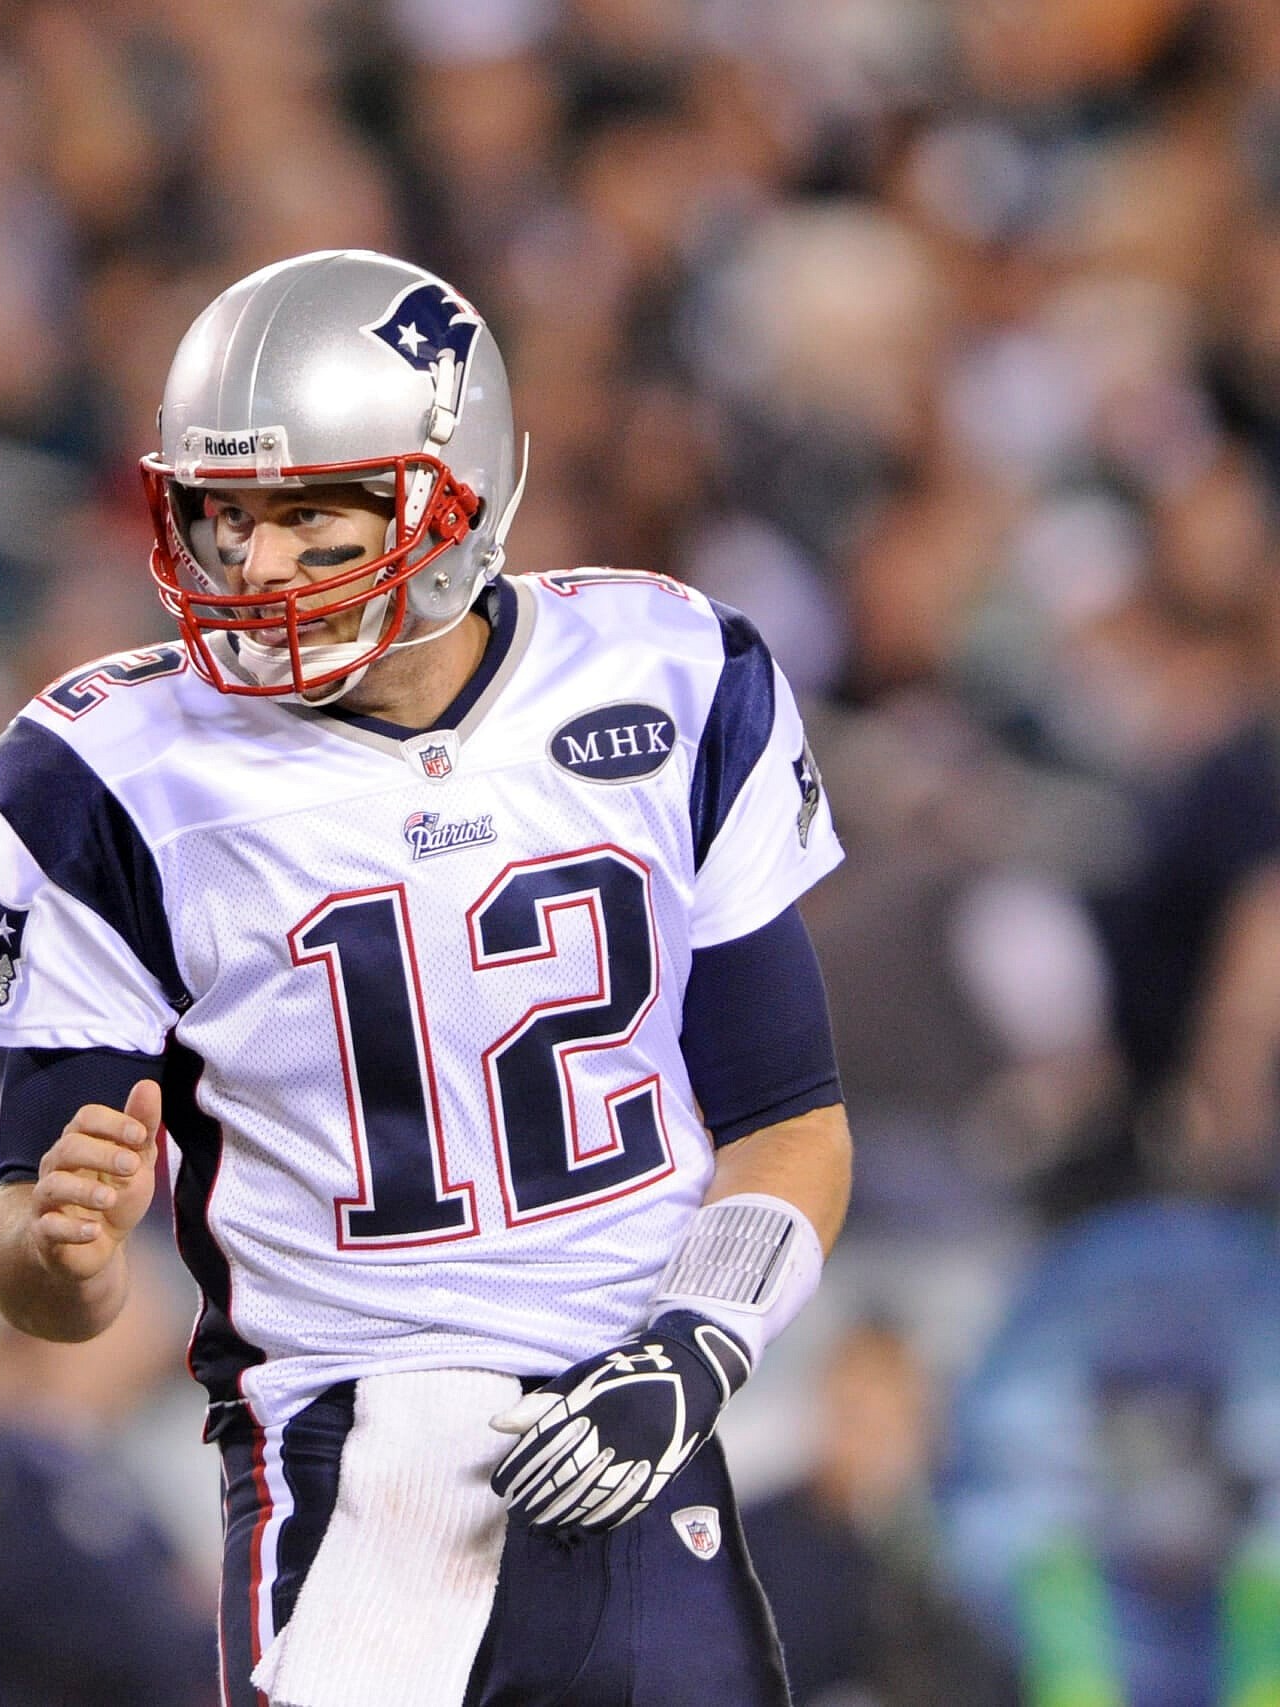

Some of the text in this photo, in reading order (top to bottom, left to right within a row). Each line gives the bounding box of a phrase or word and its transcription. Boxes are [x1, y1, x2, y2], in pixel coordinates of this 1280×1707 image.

[562, 721, 671, 765] MHK
[404, 812, 498, 861] Patriots
[288, 843, 675, 1251] 12
